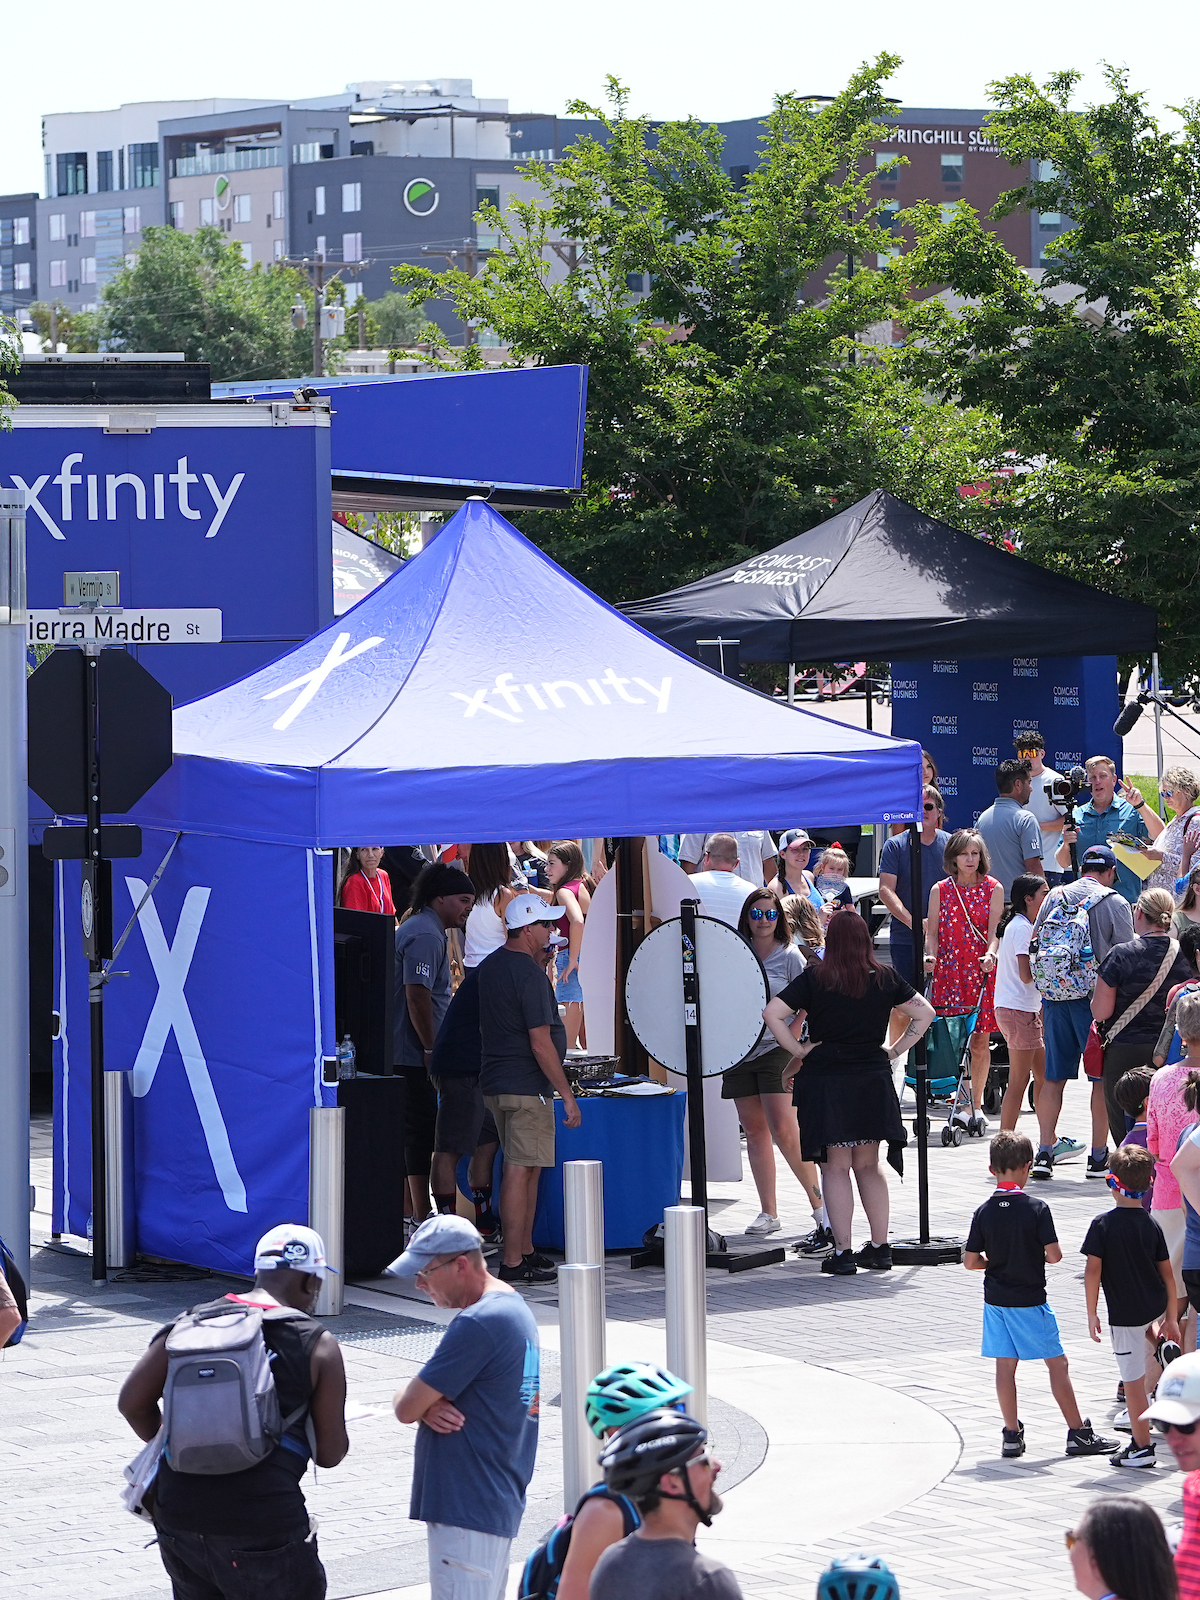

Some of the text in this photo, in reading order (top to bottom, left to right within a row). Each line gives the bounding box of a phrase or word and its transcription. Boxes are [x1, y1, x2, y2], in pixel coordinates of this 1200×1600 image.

[10, 453, 246, 540] xfinity
[748, 554, 831, 571] COMCAST
[78, 577, 103, 600] Vermijo
[29, 615, 200, 641] ierra Madre St
[1013, 658, 1038, 667] COMCAST
[932, 664, 958, 674] BUSINESS
[1013, 668, 1039, 677] BUSINESS
[893, 680, 918, 690] COMCAST
[972, 682, 998, 692] COMCAST
[450, 667, 673, 723] xfinity
[893, 690, 918, 699] BUSINESS
[1053, 686, 1079, 696] COMCAST
[973, 692, 998, 701] BUSINESS
[1053, 697, 1080, 706] BUSINESS
[932, 715, 958, 725] COMCAST
[1013, 719, 1039, 729] COMCAST
[932, 726, 958, 735] BUSINESS
[972, 746, 998, 756] COMCAST
[1055, 751, 1082, 761] COMCAST
[972, 756, 999, 766] BUSINESS
[936, 777, 958, 787] OMCAST
[939, 786, 958, 796] SINESS
[415, 965, 430, 978] USA
[685, 1009, 696, 1020] 14
[647, 1436, 677, 1450] GIRO
